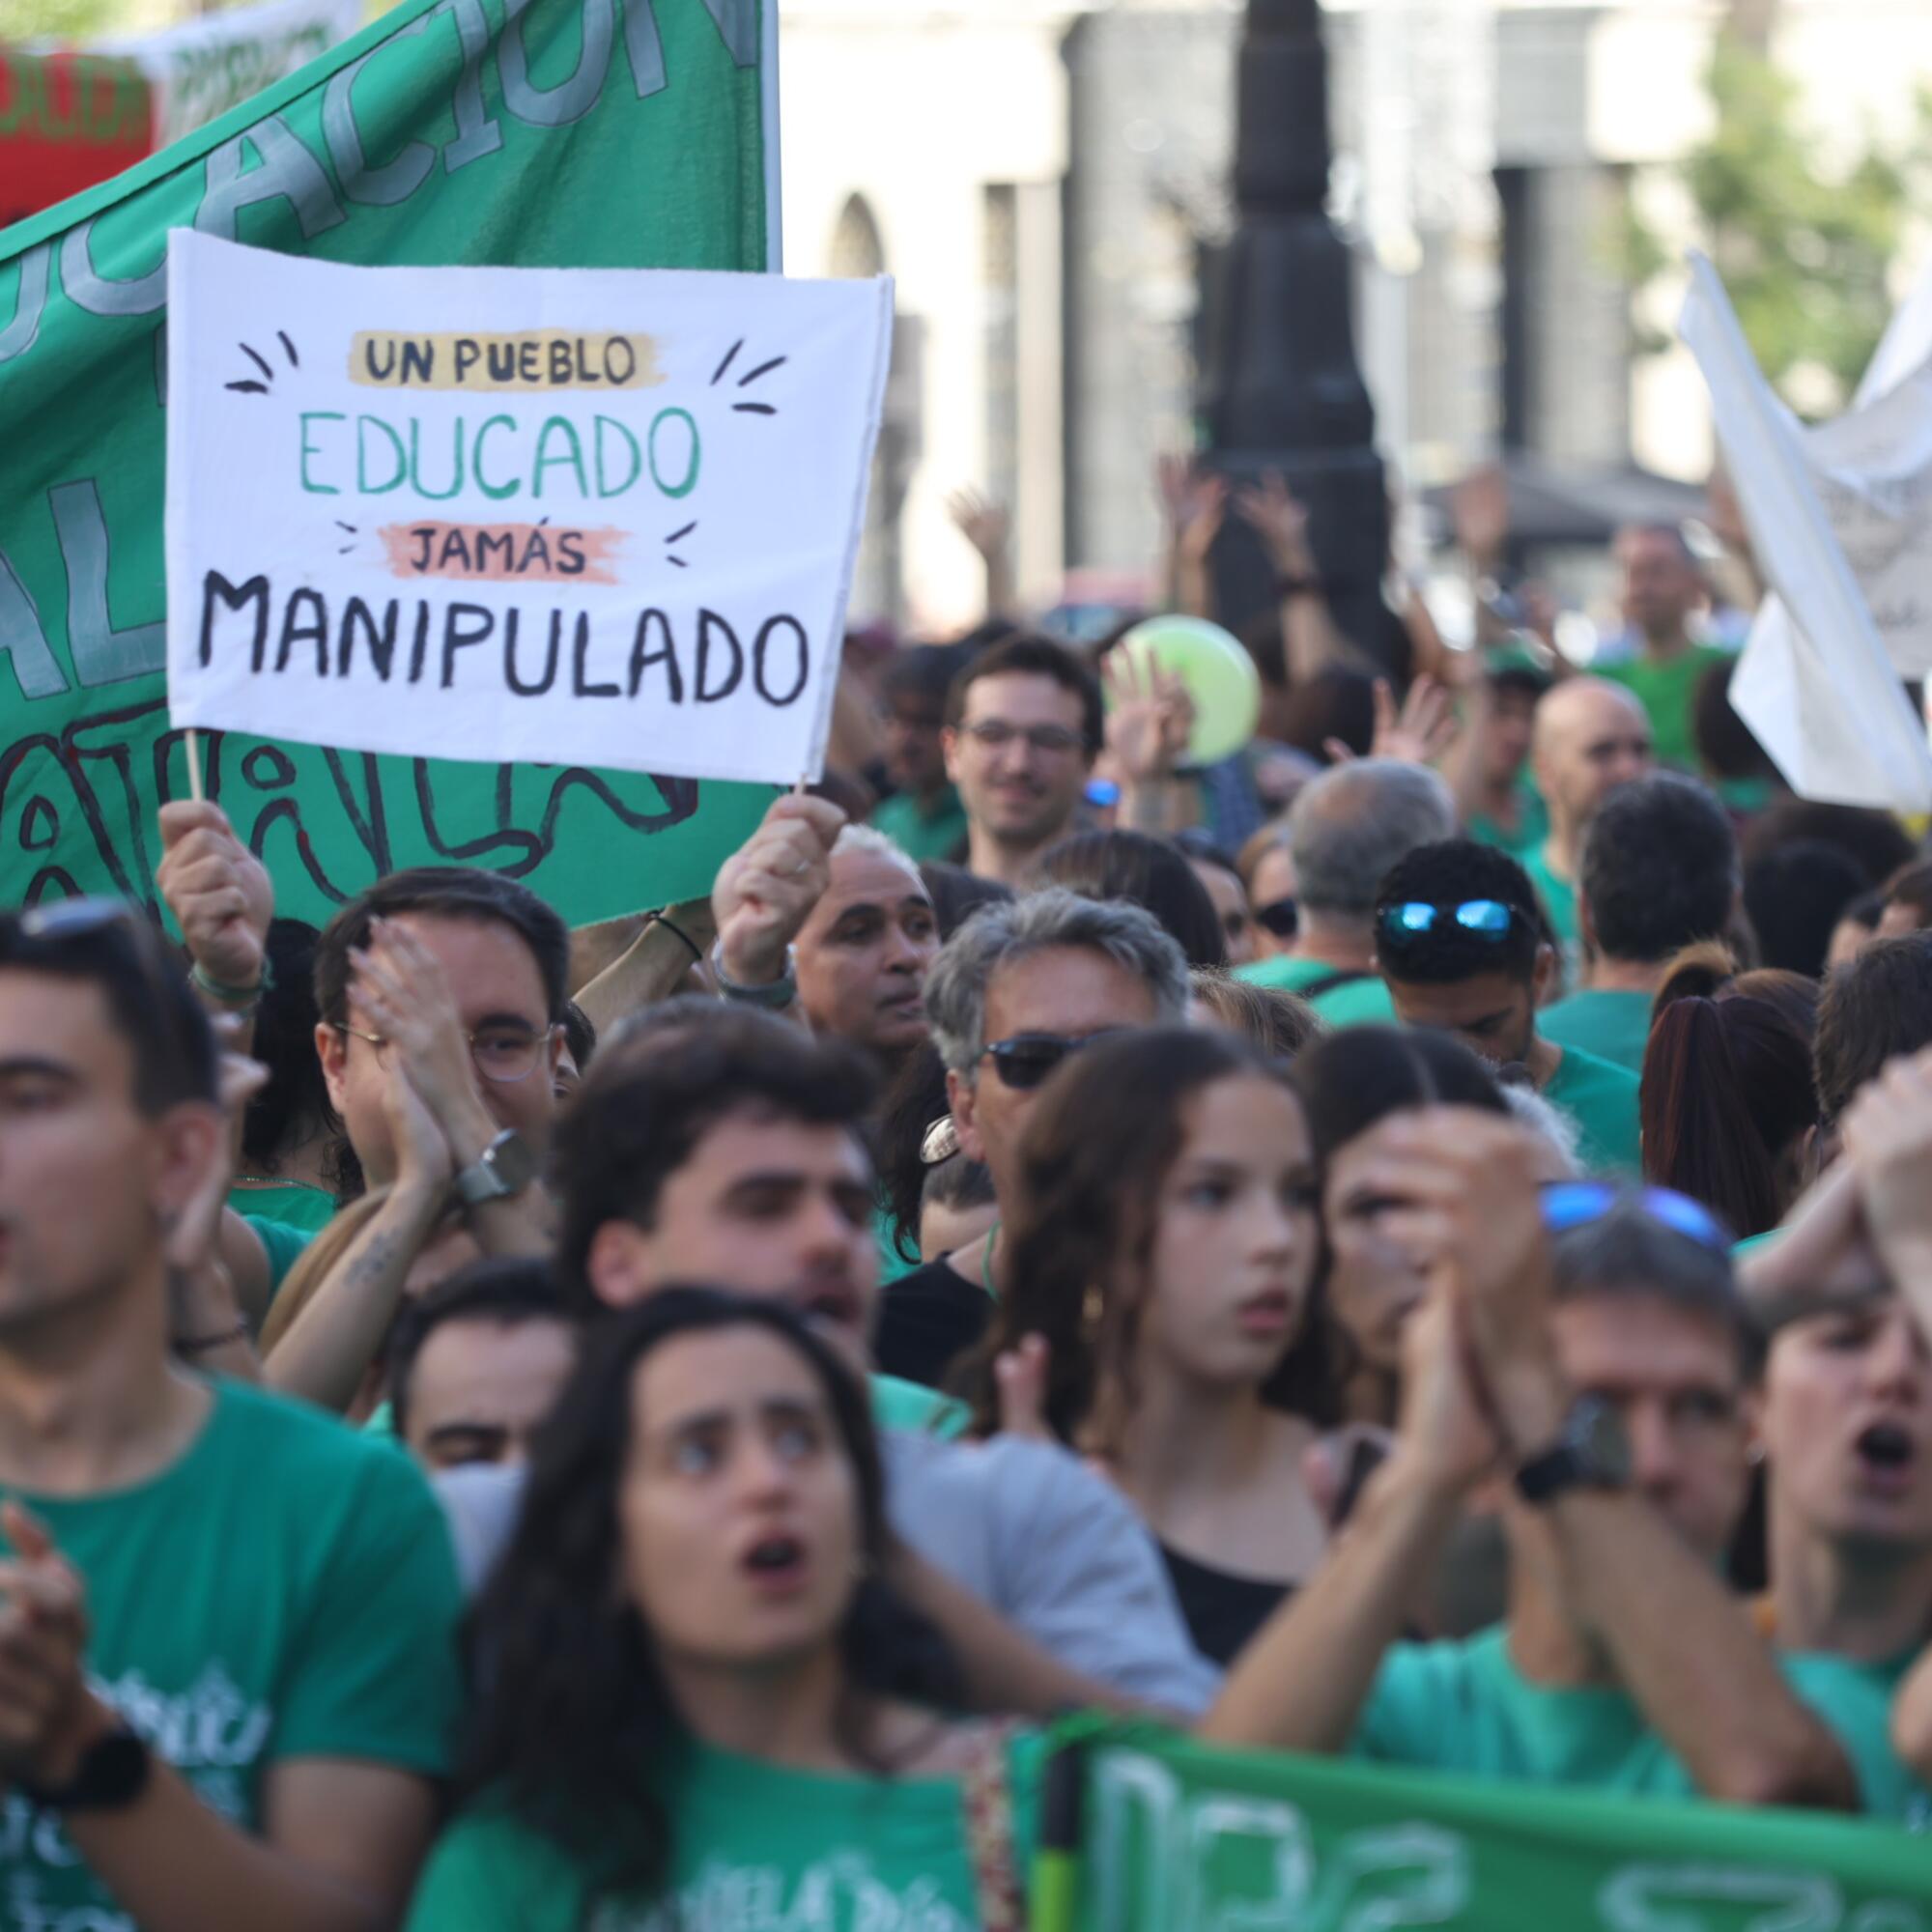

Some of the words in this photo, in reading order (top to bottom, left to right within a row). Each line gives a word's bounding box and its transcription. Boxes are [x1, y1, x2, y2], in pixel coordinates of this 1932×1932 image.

[365, 338, 434, 384] UN
[454, 335, 637, 385] PUEBLO
[299, 406, 701, 500] EDUCADO
[410, 516, 586, 575] JAMÁS
[198, 568, 810, 707] MANIPULADO
